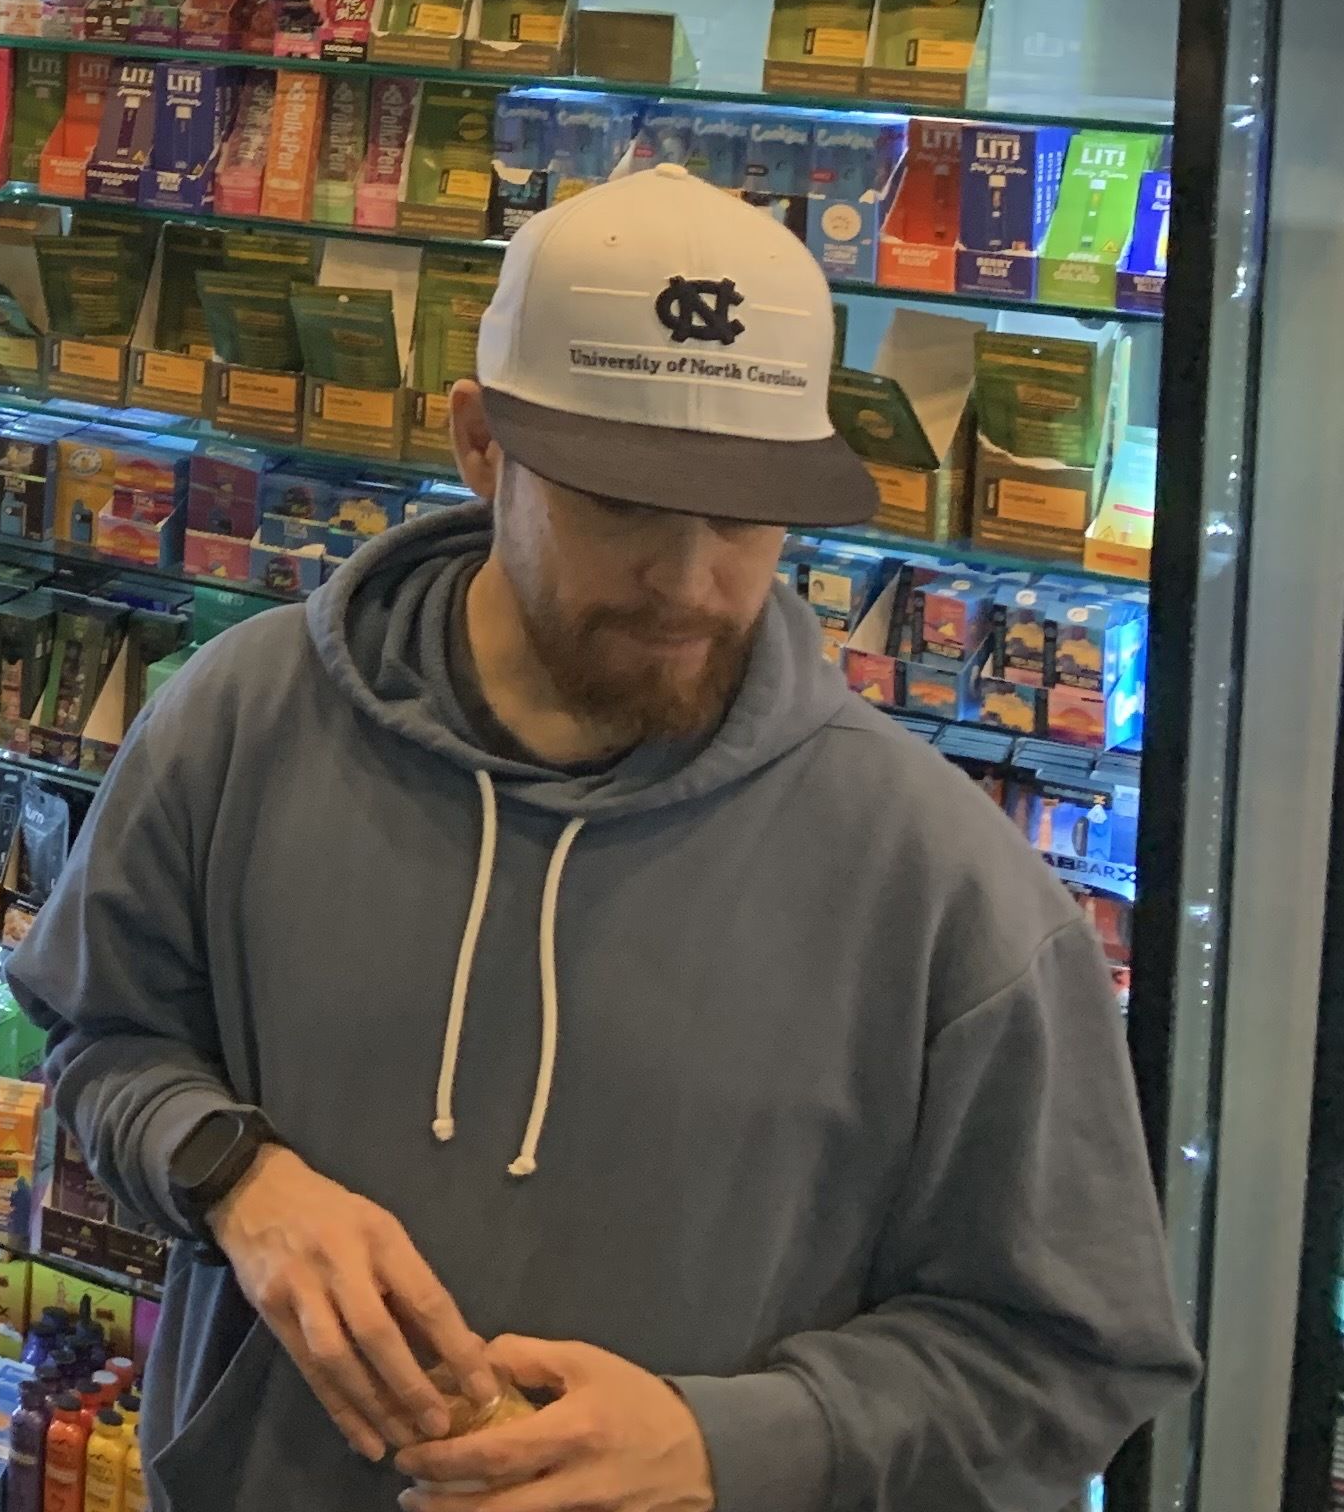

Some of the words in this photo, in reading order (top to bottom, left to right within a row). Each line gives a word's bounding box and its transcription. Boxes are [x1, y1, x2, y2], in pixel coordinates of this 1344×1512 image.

[120, 66, 154, 85] LIT!
[167, 71, 202, 93] LIT!
[976, 138, 1021, 161] LIT!
[1080, 148, 1125, 168] LIT!
[570, 348, 662, 374] University
[666, 357, 687, 374] of
[690, 359, 742, 380] North
[747, 366, 808, 388] Carolina
